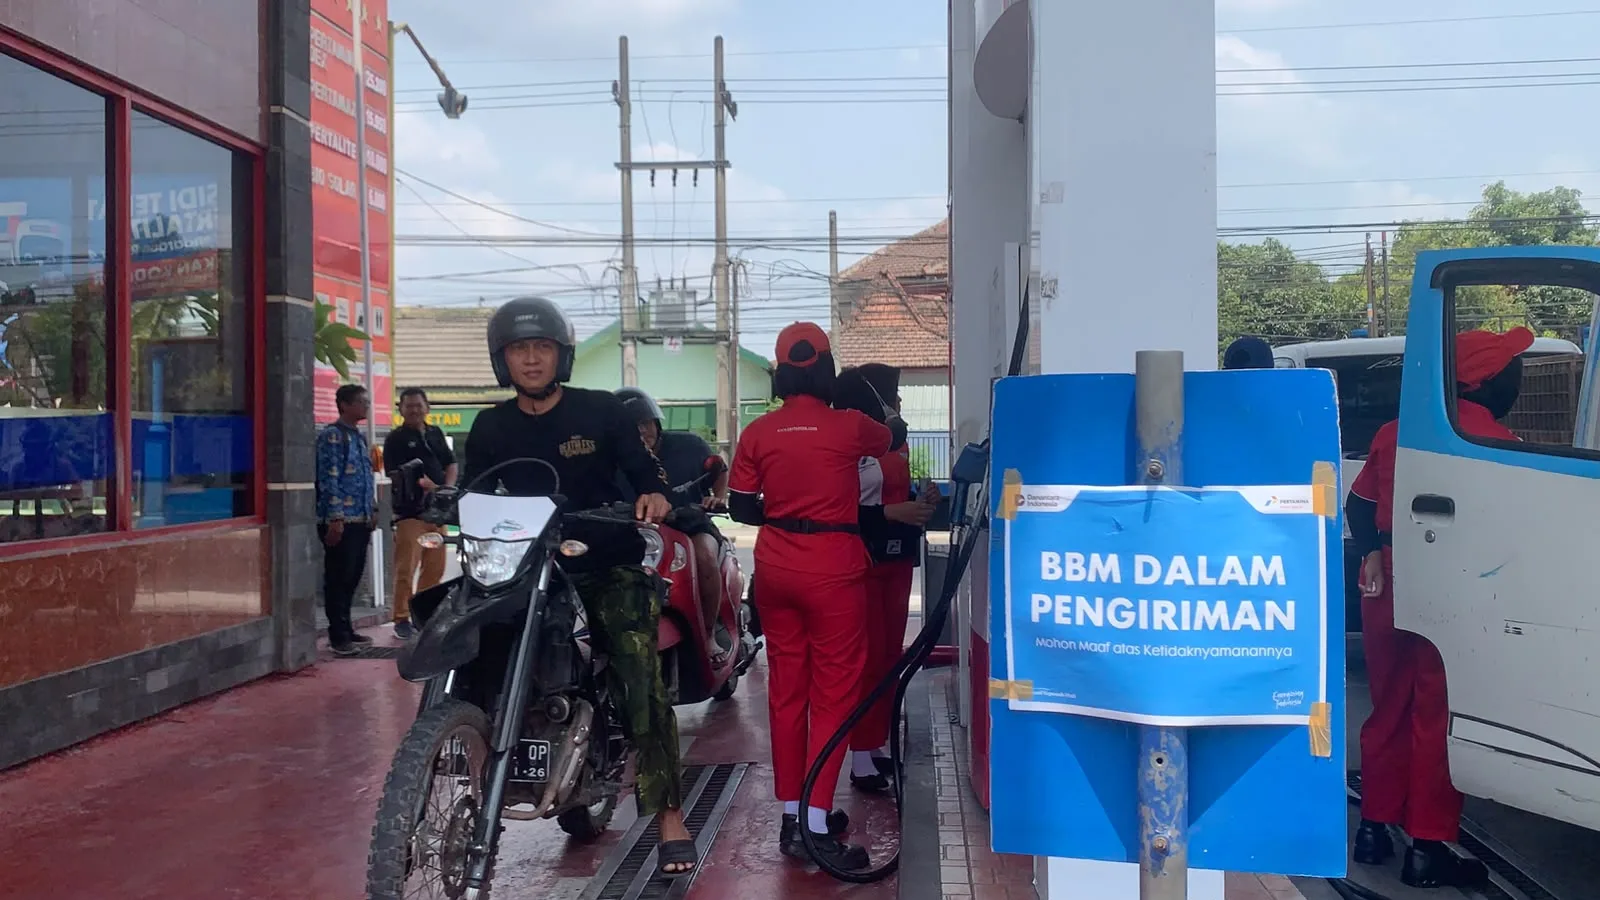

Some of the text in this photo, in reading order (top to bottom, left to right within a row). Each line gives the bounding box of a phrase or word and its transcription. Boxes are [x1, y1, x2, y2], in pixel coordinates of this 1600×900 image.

[1040, 551, 1286, 586] BBM DALAM
[1031, 593, 1296, 631] PENGIRIMAN
[1035, 637, 1293, 660] Mohon Maaf atas Ketidaknyamanannya
